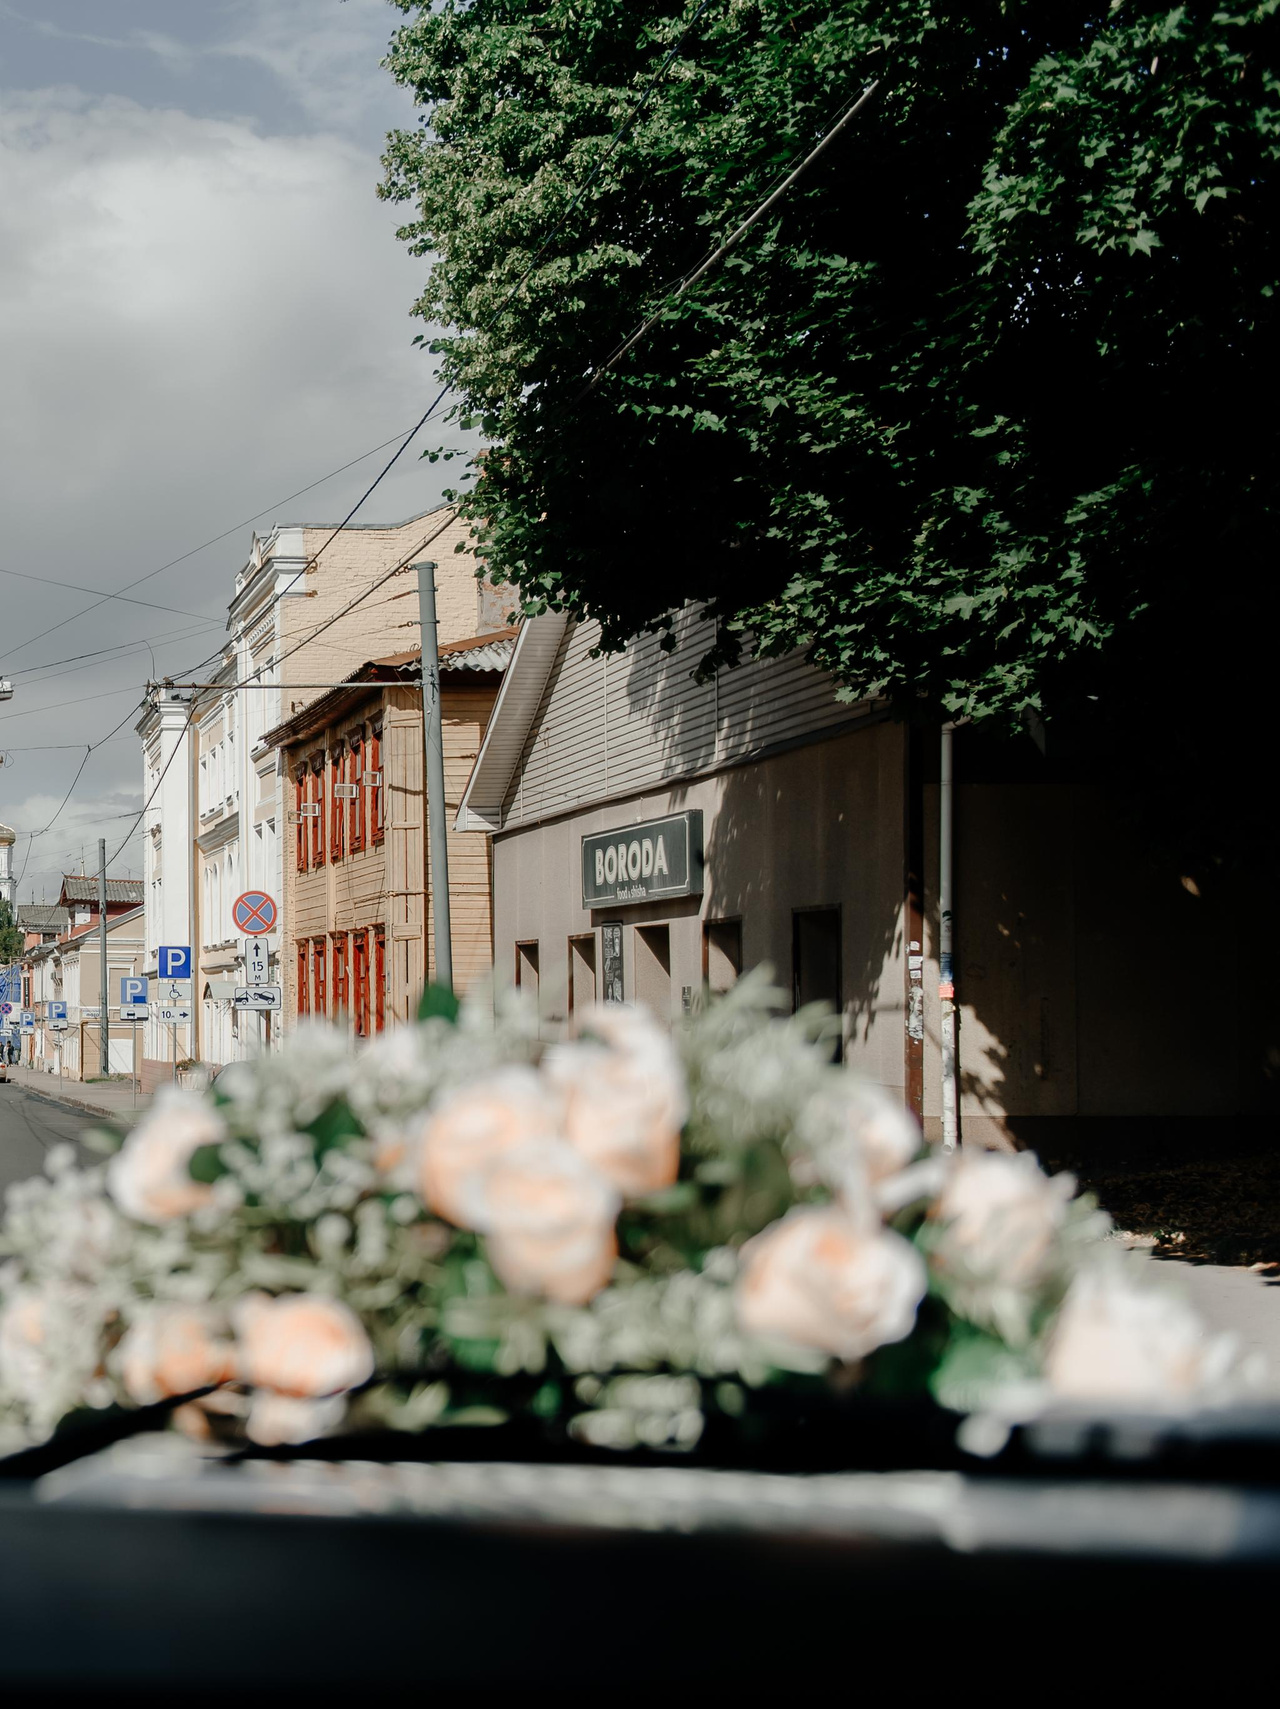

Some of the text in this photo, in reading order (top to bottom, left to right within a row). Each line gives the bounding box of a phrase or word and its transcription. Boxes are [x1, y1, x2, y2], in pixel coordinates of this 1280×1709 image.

[595, 835, 669, 886] BORODA
[617, 886, 628, 900] food
[631, 884, 646, 898] shisha
[167, 948, 186, 976] P
[252, 961, 264, 972] 15
[126, 980, 143, 1002] P
[52, 1003, 63, 1018] P
[162, 1010, 172, 1019] 10
[23, 1013, 32, 1026] P
